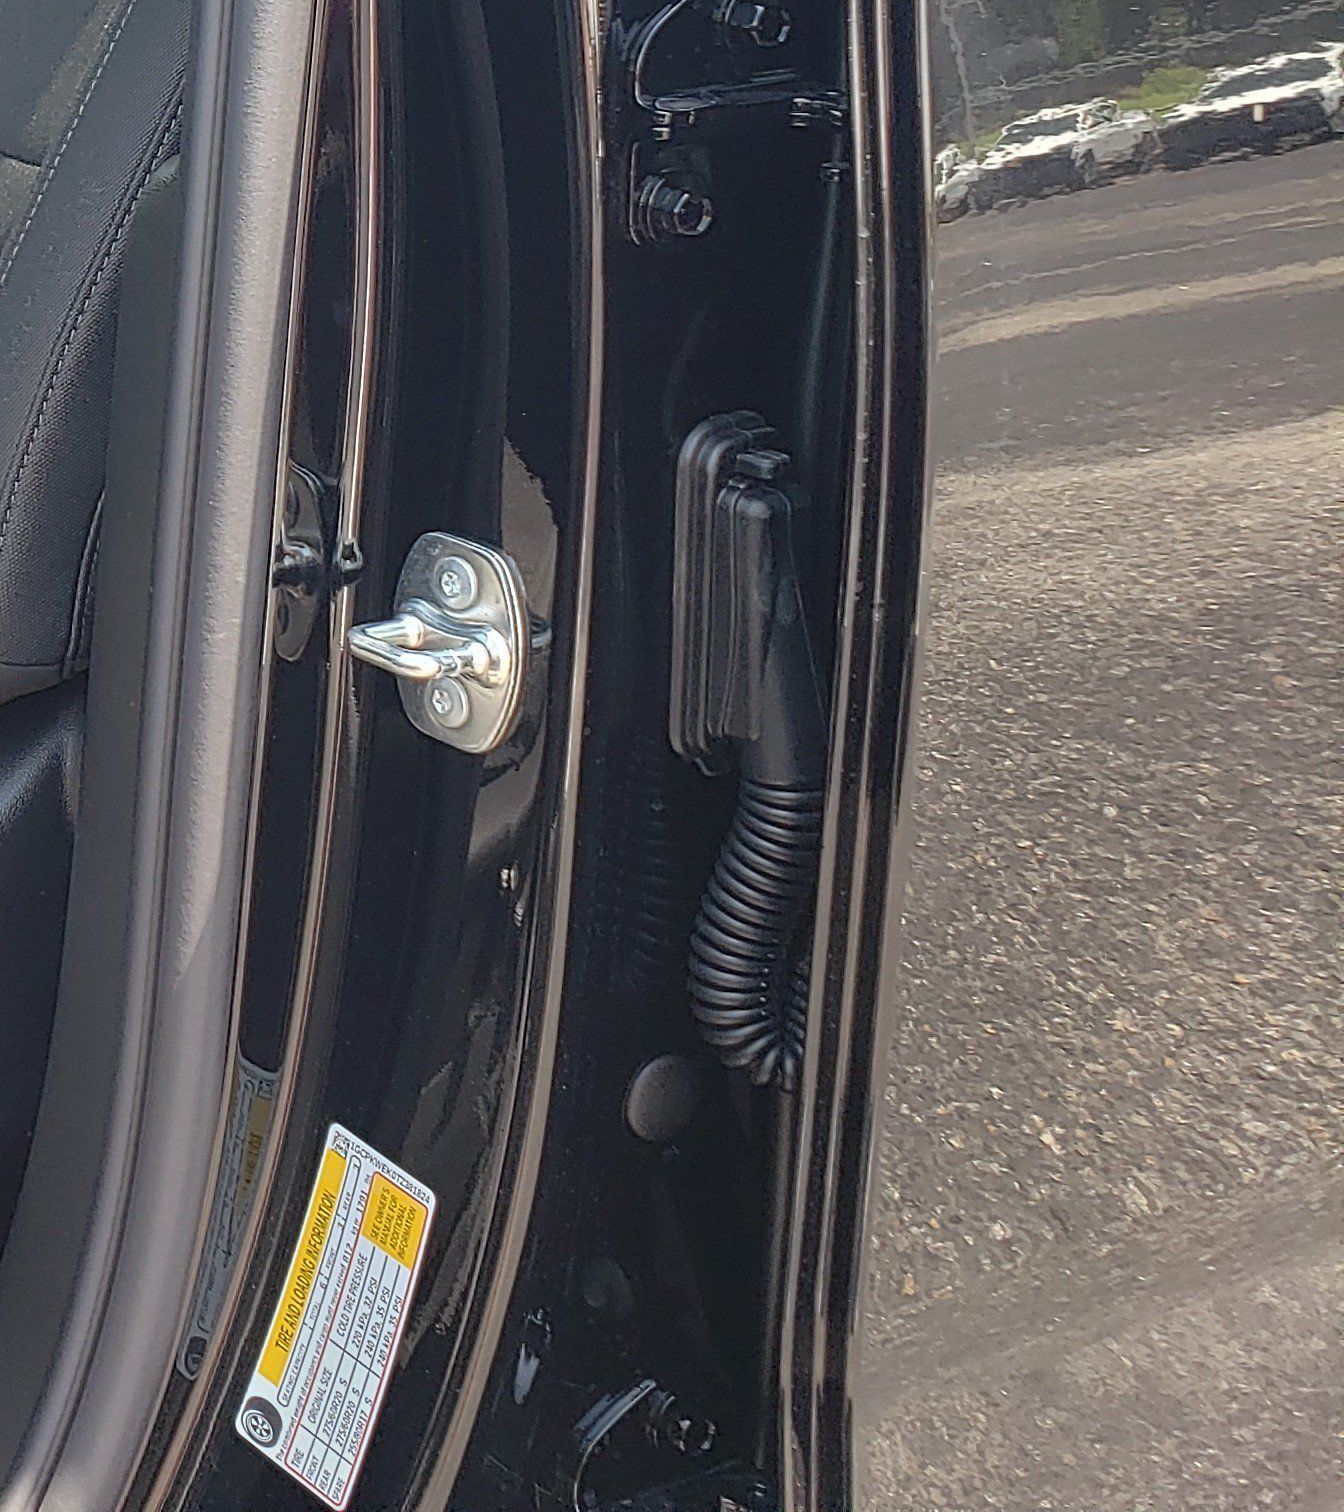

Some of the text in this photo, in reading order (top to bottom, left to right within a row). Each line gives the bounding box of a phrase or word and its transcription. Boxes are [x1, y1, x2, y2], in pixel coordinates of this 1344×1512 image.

[387, 1194, 398, 1213] FOR
[389, 1204, 407, 1250] ADDITIONAL
[275, 1190, 335, 1352] TIRE AND LOADING INFORMATION
[336, 1252, 367, 1337] COLD TIRE PRESSURE
[367, 1276, 377, 1295] PSI
[379, 1285, 390, 1304] PSI
[363, 1295, 372, 1309] 32
[375, 1305, 385, 1318] 35
[351, 1330, 362, 1348] 220
[376, 1348, 387, 1367] 240
[392, 1295, 402, 1313] PSI
[363, 1339, 375, 1358] 240
[307, 1367, 332, 1424] ORIGINAL SIZE
[335, 1400, 355, 1446] 275/60R20
[290, 1448, 304, 1468] TIRE
[305, 1454, 319, 1480] FRONT
[318, 1469, 331, 1491] REAR
[331, 1477, 345, 1501] SPARE
